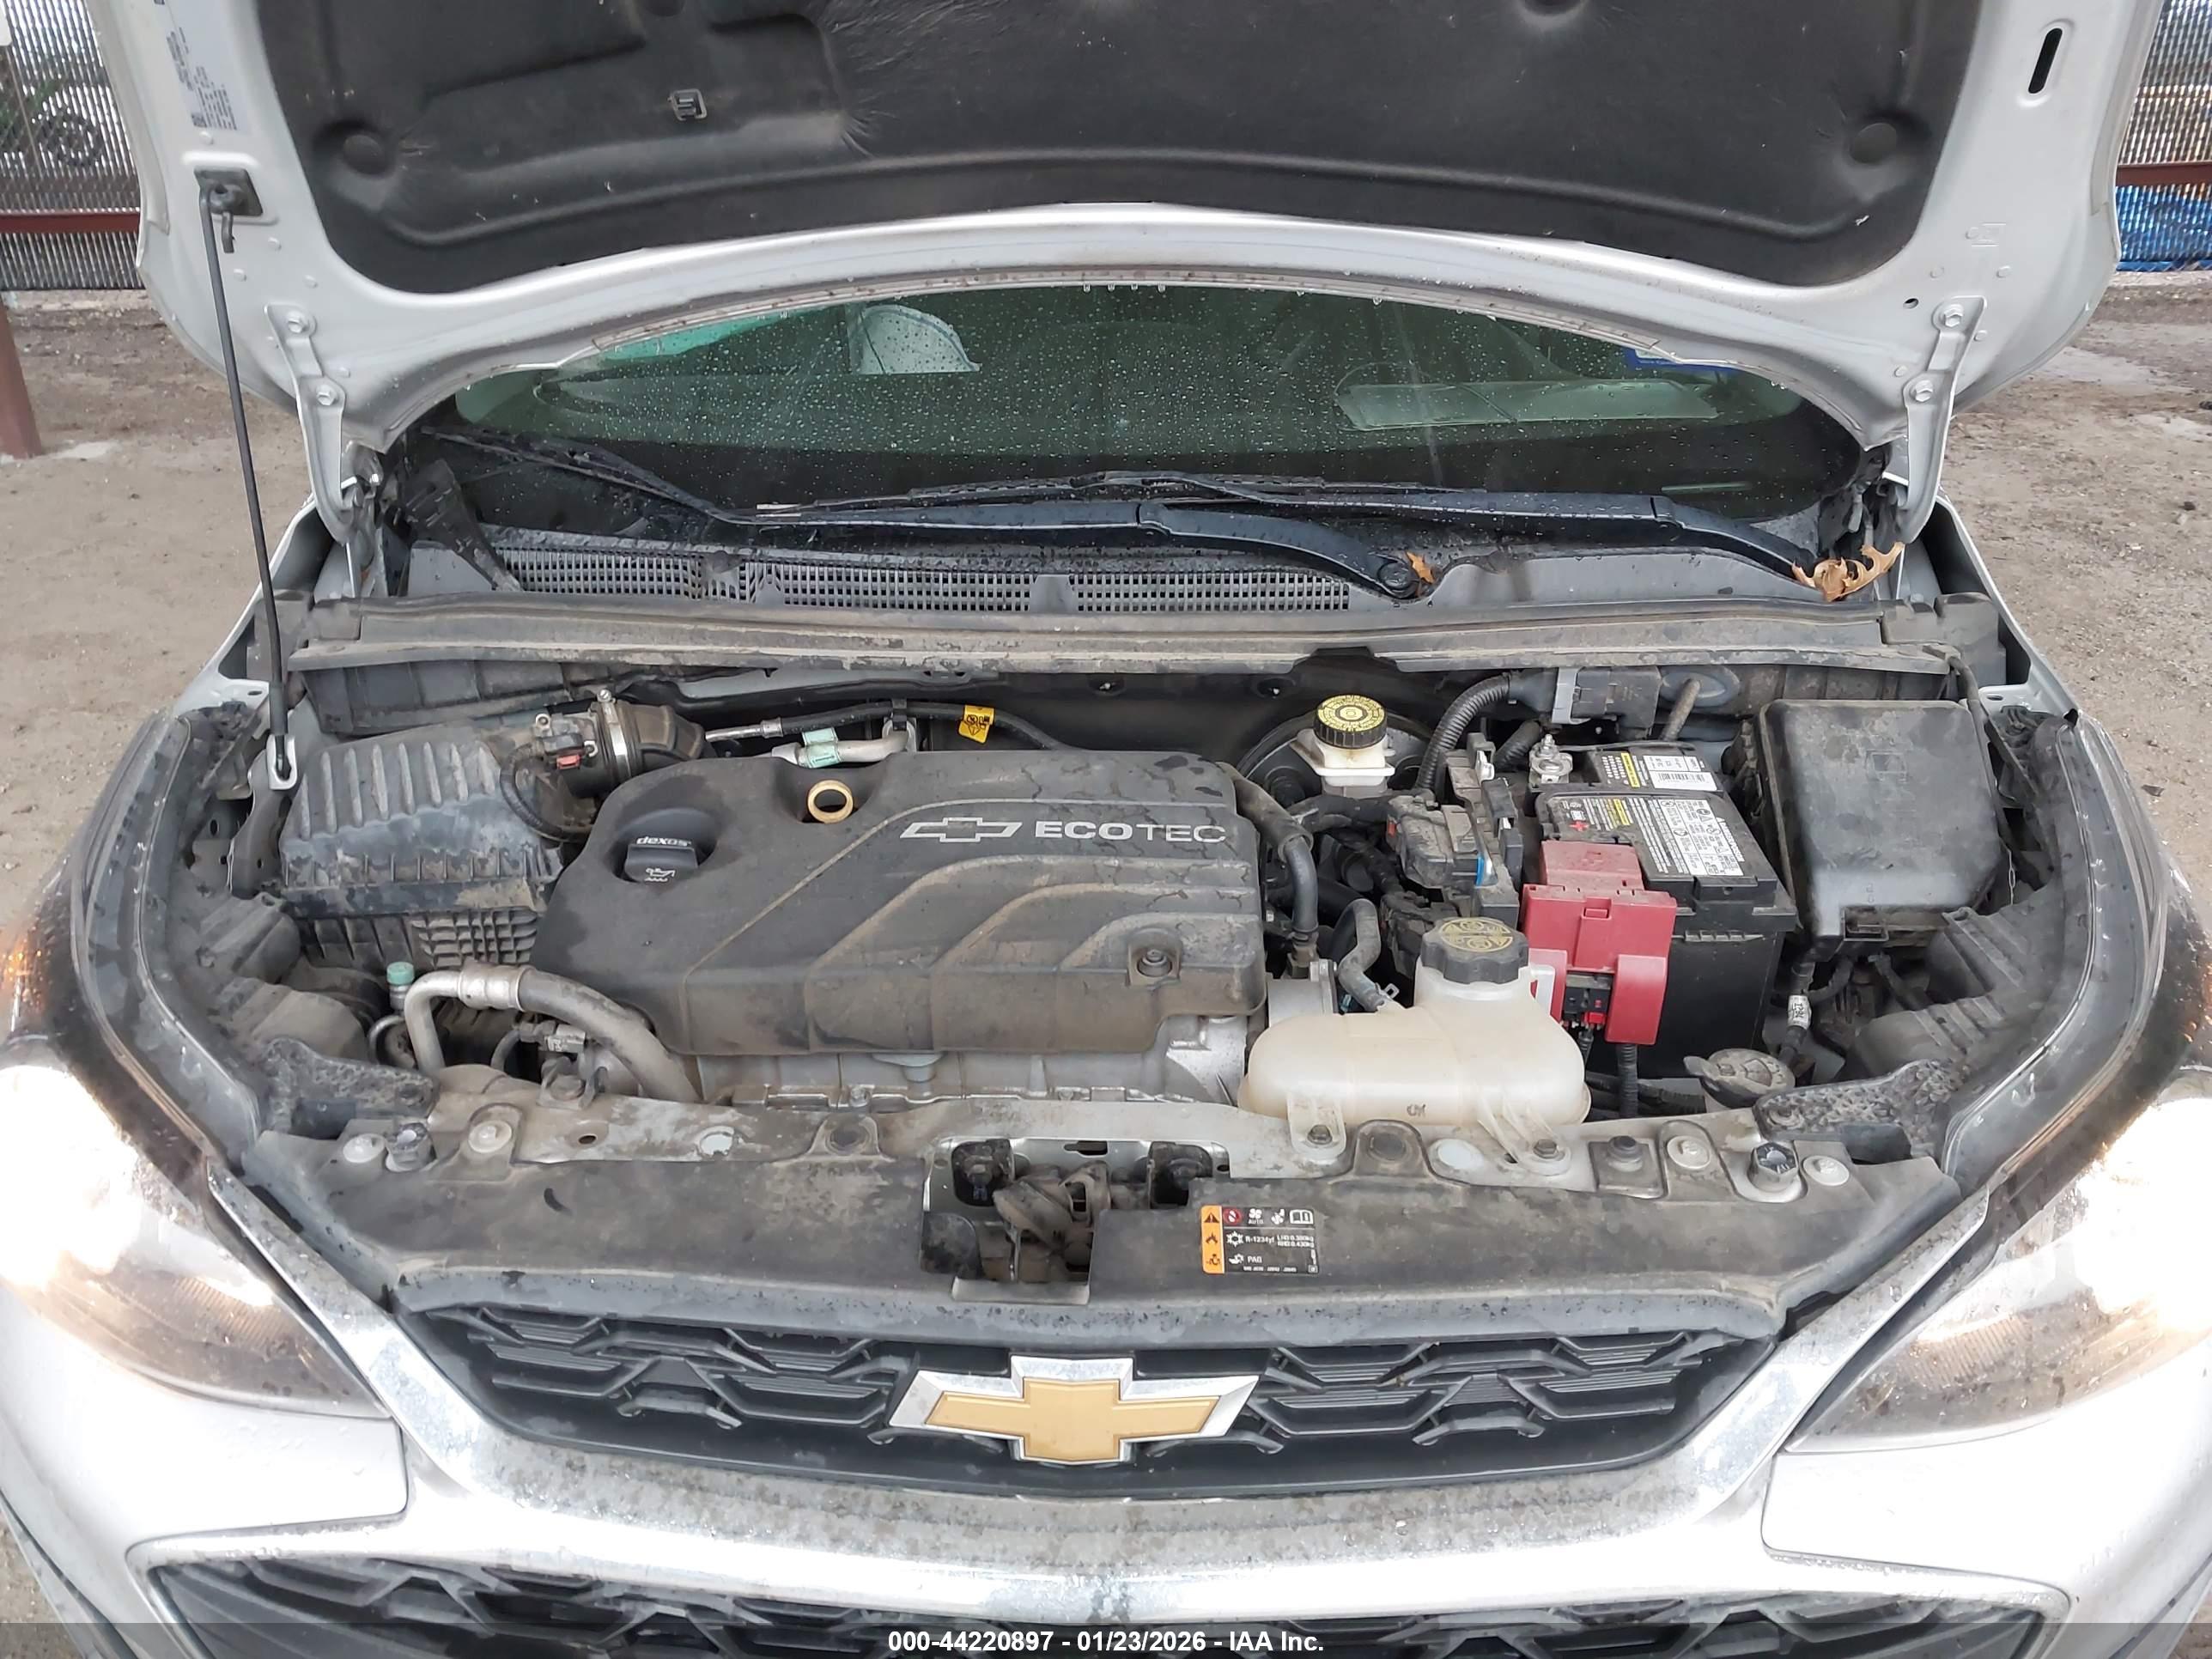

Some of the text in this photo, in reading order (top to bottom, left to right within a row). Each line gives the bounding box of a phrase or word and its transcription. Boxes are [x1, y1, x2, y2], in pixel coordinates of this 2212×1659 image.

[1035, 821, 1226, 843] ECOTEC
[636, 836, 688, 847] dexos
[1247, 1255, 1262, 1264] PAG
